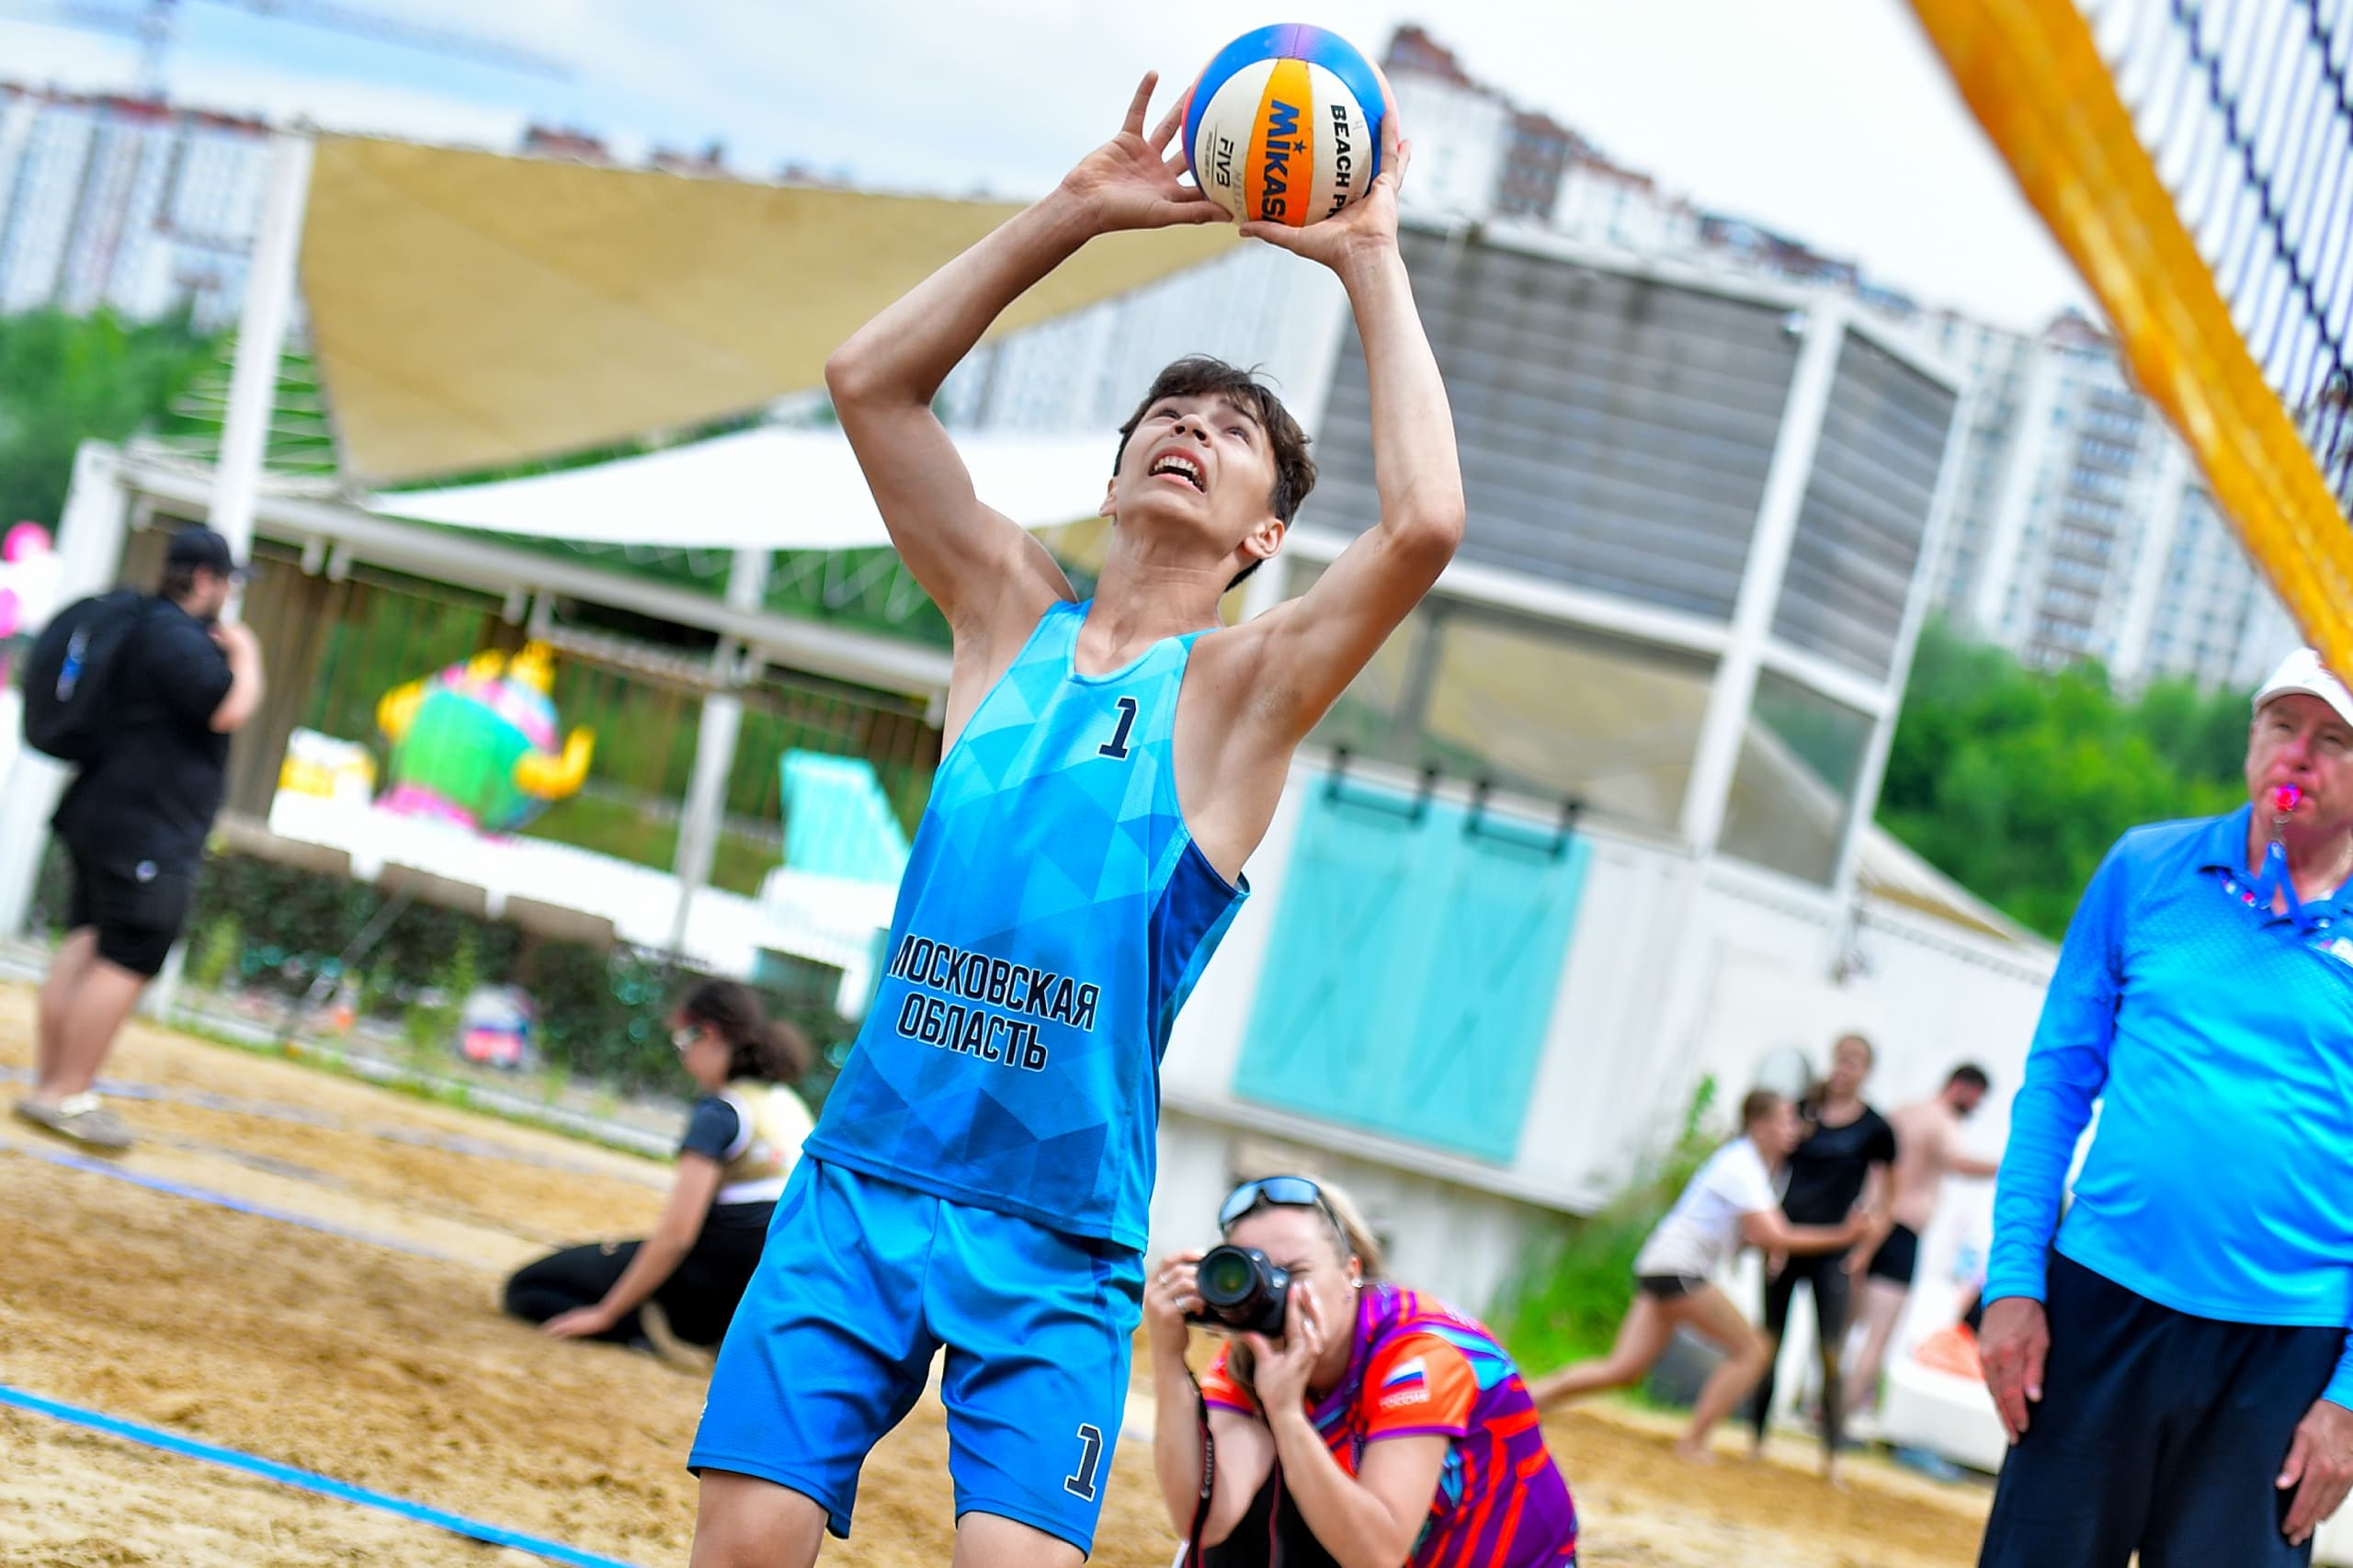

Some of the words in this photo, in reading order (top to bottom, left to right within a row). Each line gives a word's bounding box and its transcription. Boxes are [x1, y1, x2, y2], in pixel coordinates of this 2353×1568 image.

[1330, 104, 1351, 188] BEACH
[1097, 696, 1138, 761] 1
[889, 935, 1100, 1032] МОСКОВСКАЯ
[896, 993, 1047, 1072] ОБЛАСТЬ
[1064, 1423, 1103, 1502] 1
